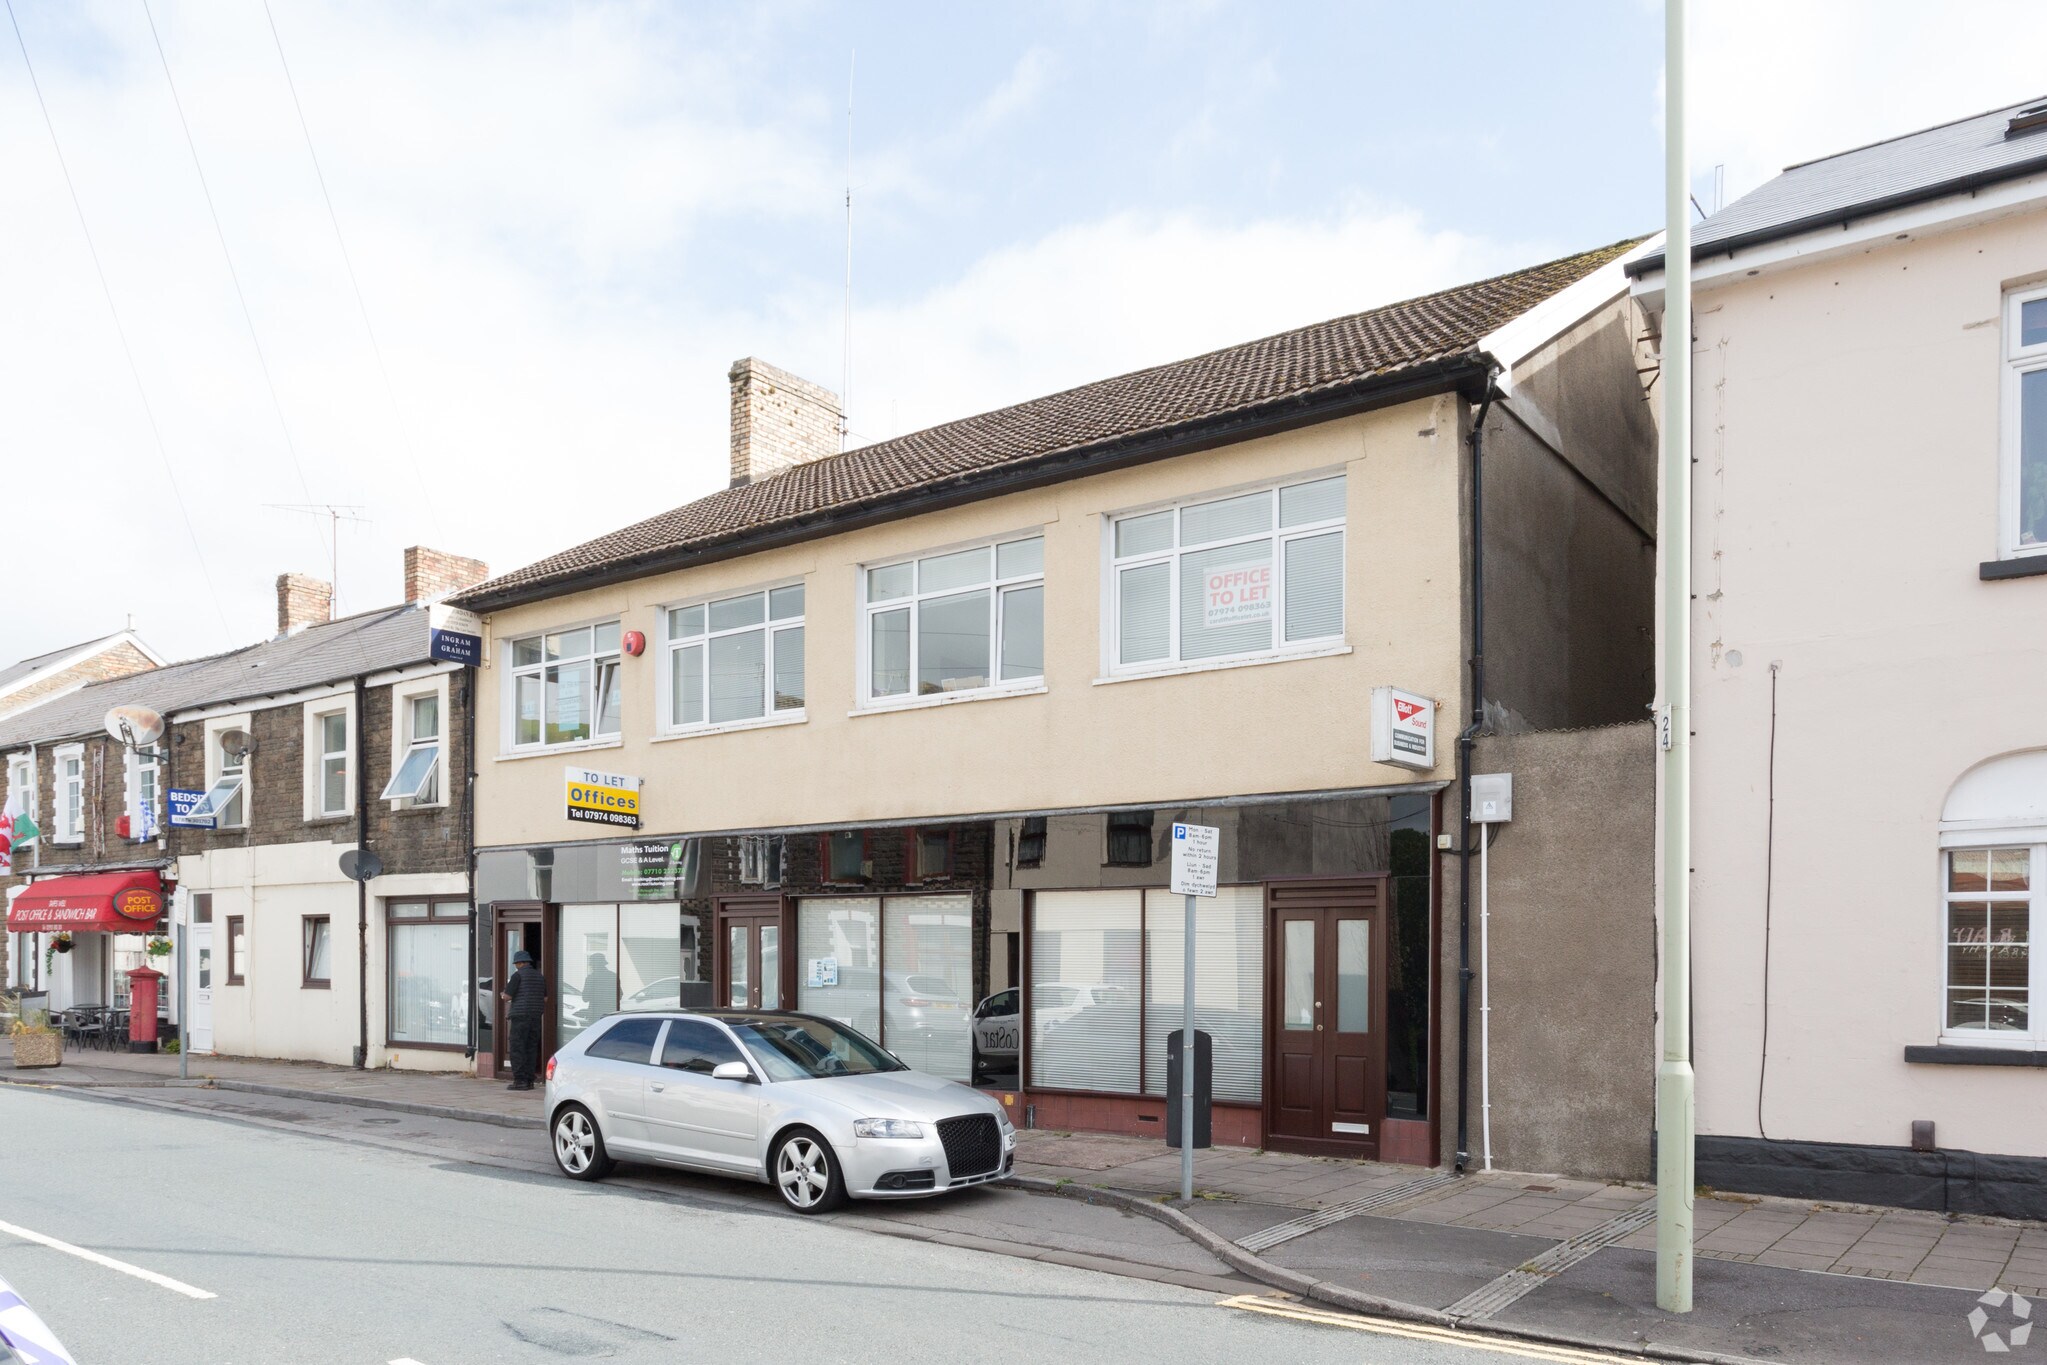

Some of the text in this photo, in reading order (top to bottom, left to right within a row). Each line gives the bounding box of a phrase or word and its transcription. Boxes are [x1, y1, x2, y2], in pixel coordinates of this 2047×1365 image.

[1209, 567, 1270, 590] OFFICE
[1210, 584, 1270, 606] TO LET
[1208, 601, 1271, 616] 07974 098363
[441, 635, 471, 646] INGRAM
[441, 645, 471, 656] GRAHAM
[1412, 718, 1427, 728] Sound
[584, 772, 624, 786] TO LET
[571, 788, 636, 808] Offices
[175, 804, 189, 813] TO
[571, 809, 636, 824] Tel 07974 098363
[1177, 828, 1184, 838] P
[644, 845, 669, 853] Tuition
[15, 910, 29, 920] POST
[29, 909, 48, 920] OFFICE
[54, 908, 85, 920] SANDWICH
[85, 908, 98, 920] BAR
[124, 904, 156, 913] OFFICE
